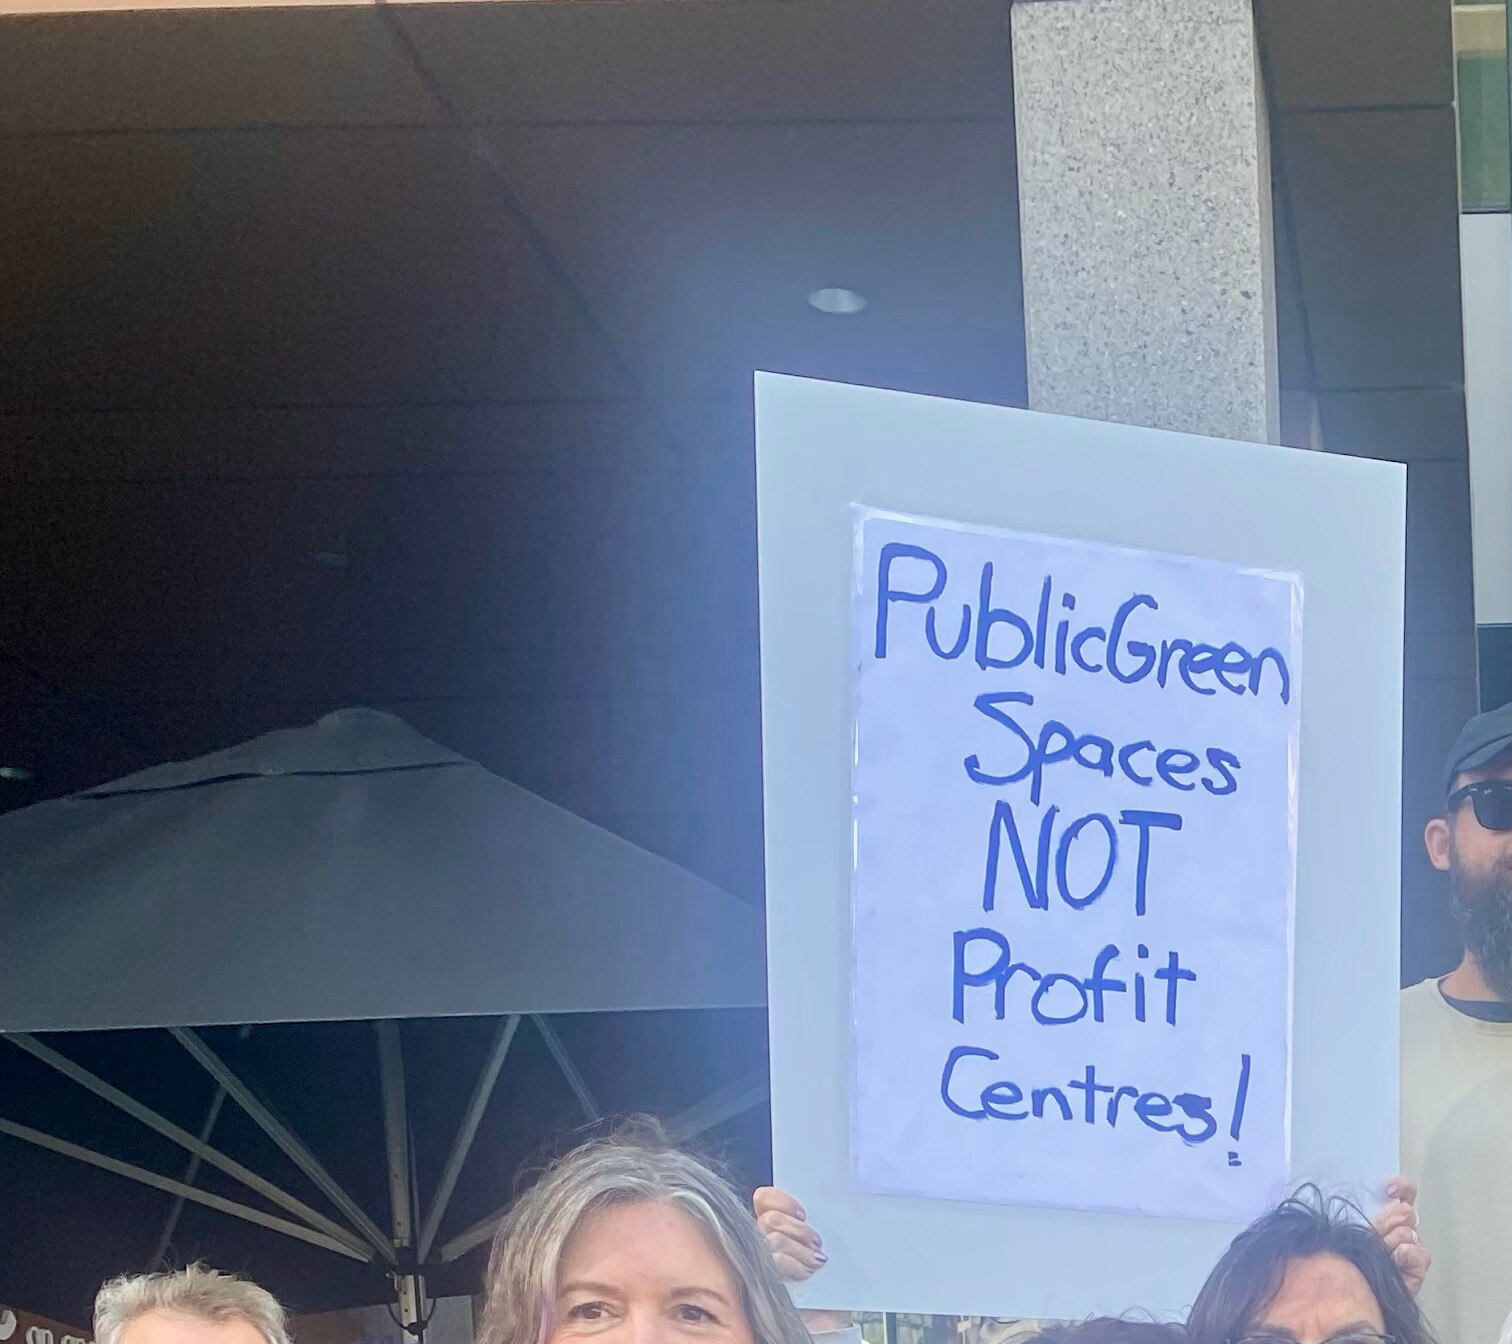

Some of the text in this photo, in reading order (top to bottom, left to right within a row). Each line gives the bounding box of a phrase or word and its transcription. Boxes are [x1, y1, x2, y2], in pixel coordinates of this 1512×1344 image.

[964, 691, 1241, 803] Spaces
[981, 803, 1182, 916] NOT
[951, 927, 1197, 1025] Profit
[941, 1045, 1252, 1167] Centres!
